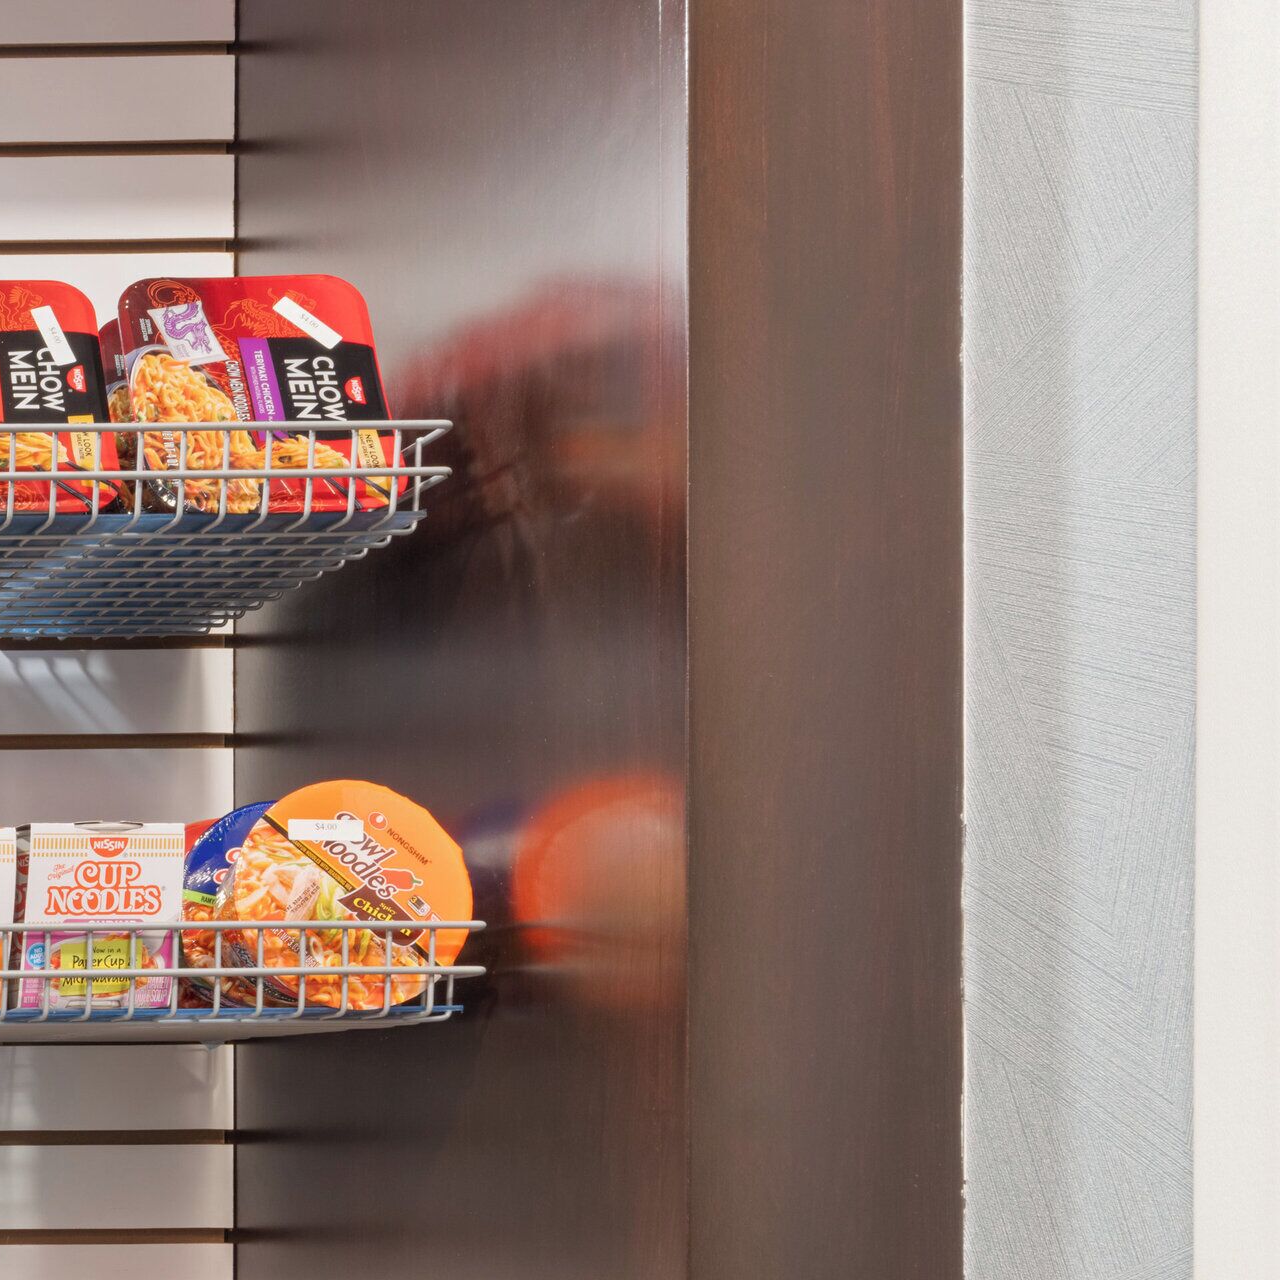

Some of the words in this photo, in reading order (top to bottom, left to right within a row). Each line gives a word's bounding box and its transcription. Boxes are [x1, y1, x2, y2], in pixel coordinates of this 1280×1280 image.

[8, 350, 40, 410] MEIN
[253, 350, 268, 383] TERIYAKI
[260, 383, 276, 415] CHICKEN
[283, 358, 322, 419] MEIN
[312, 355, 348, 421] CHOW
[93, 839, 125, 850] NISSIN
[387, 828, 430, 866] NONGSHIM
[74, 860, 142, 889] CUP
[44, 885, 162, 915] NOODLES
